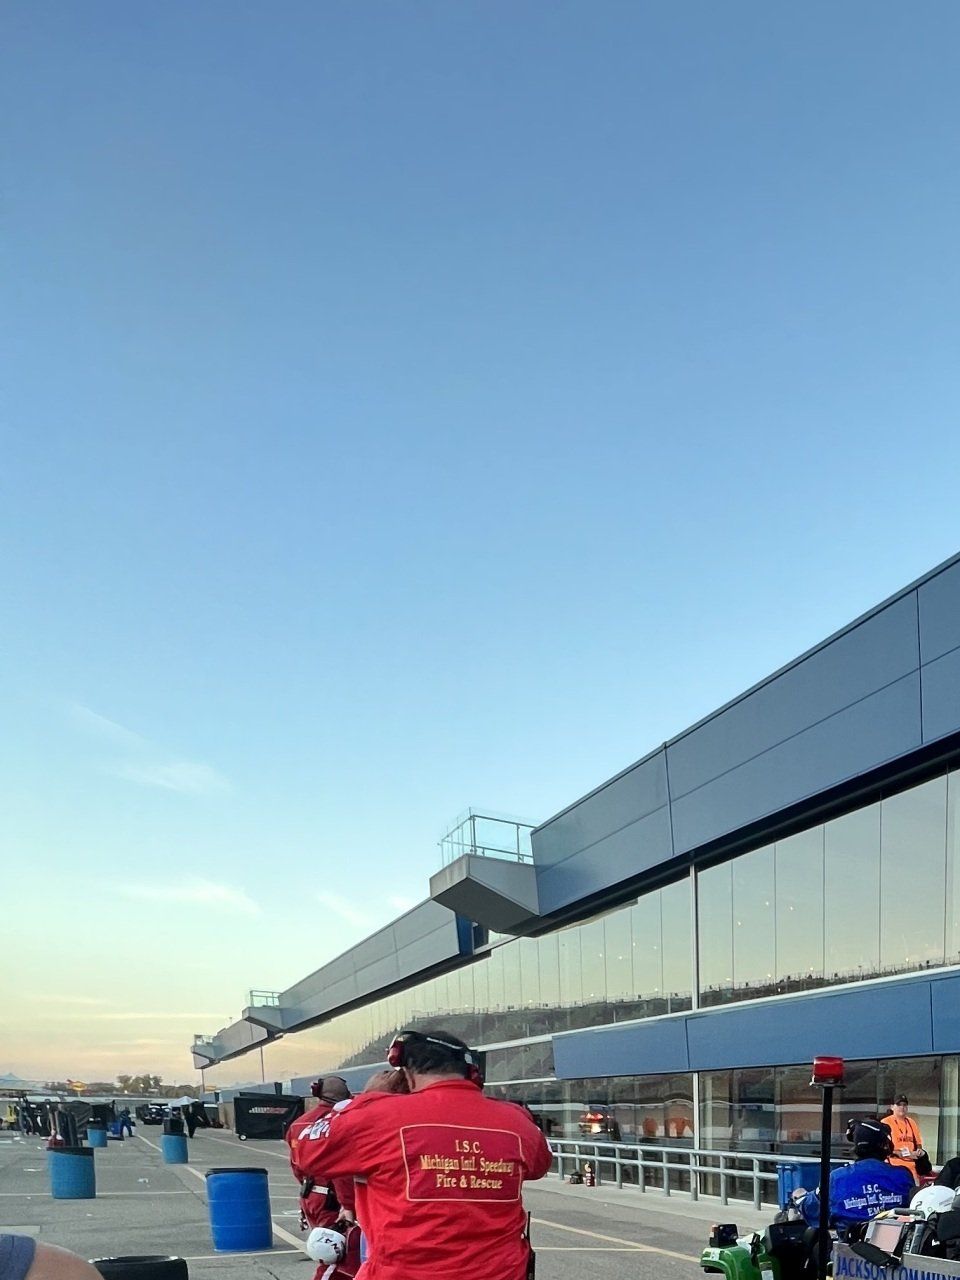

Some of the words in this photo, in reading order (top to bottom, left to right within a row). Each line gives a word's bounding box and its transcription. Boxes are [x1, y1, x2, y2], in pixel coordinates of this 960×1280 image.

[455, 1140, 484, 1154] I.S.C.
[420, 1154, 460, 1173] Michigan
[436, 1173, 458, 1188] Fire
[459, 1175, 468, 1188] &
[470, 1175, 503, 1189] Rescue
[862, 1184, 881, 1194] I.S.C.
